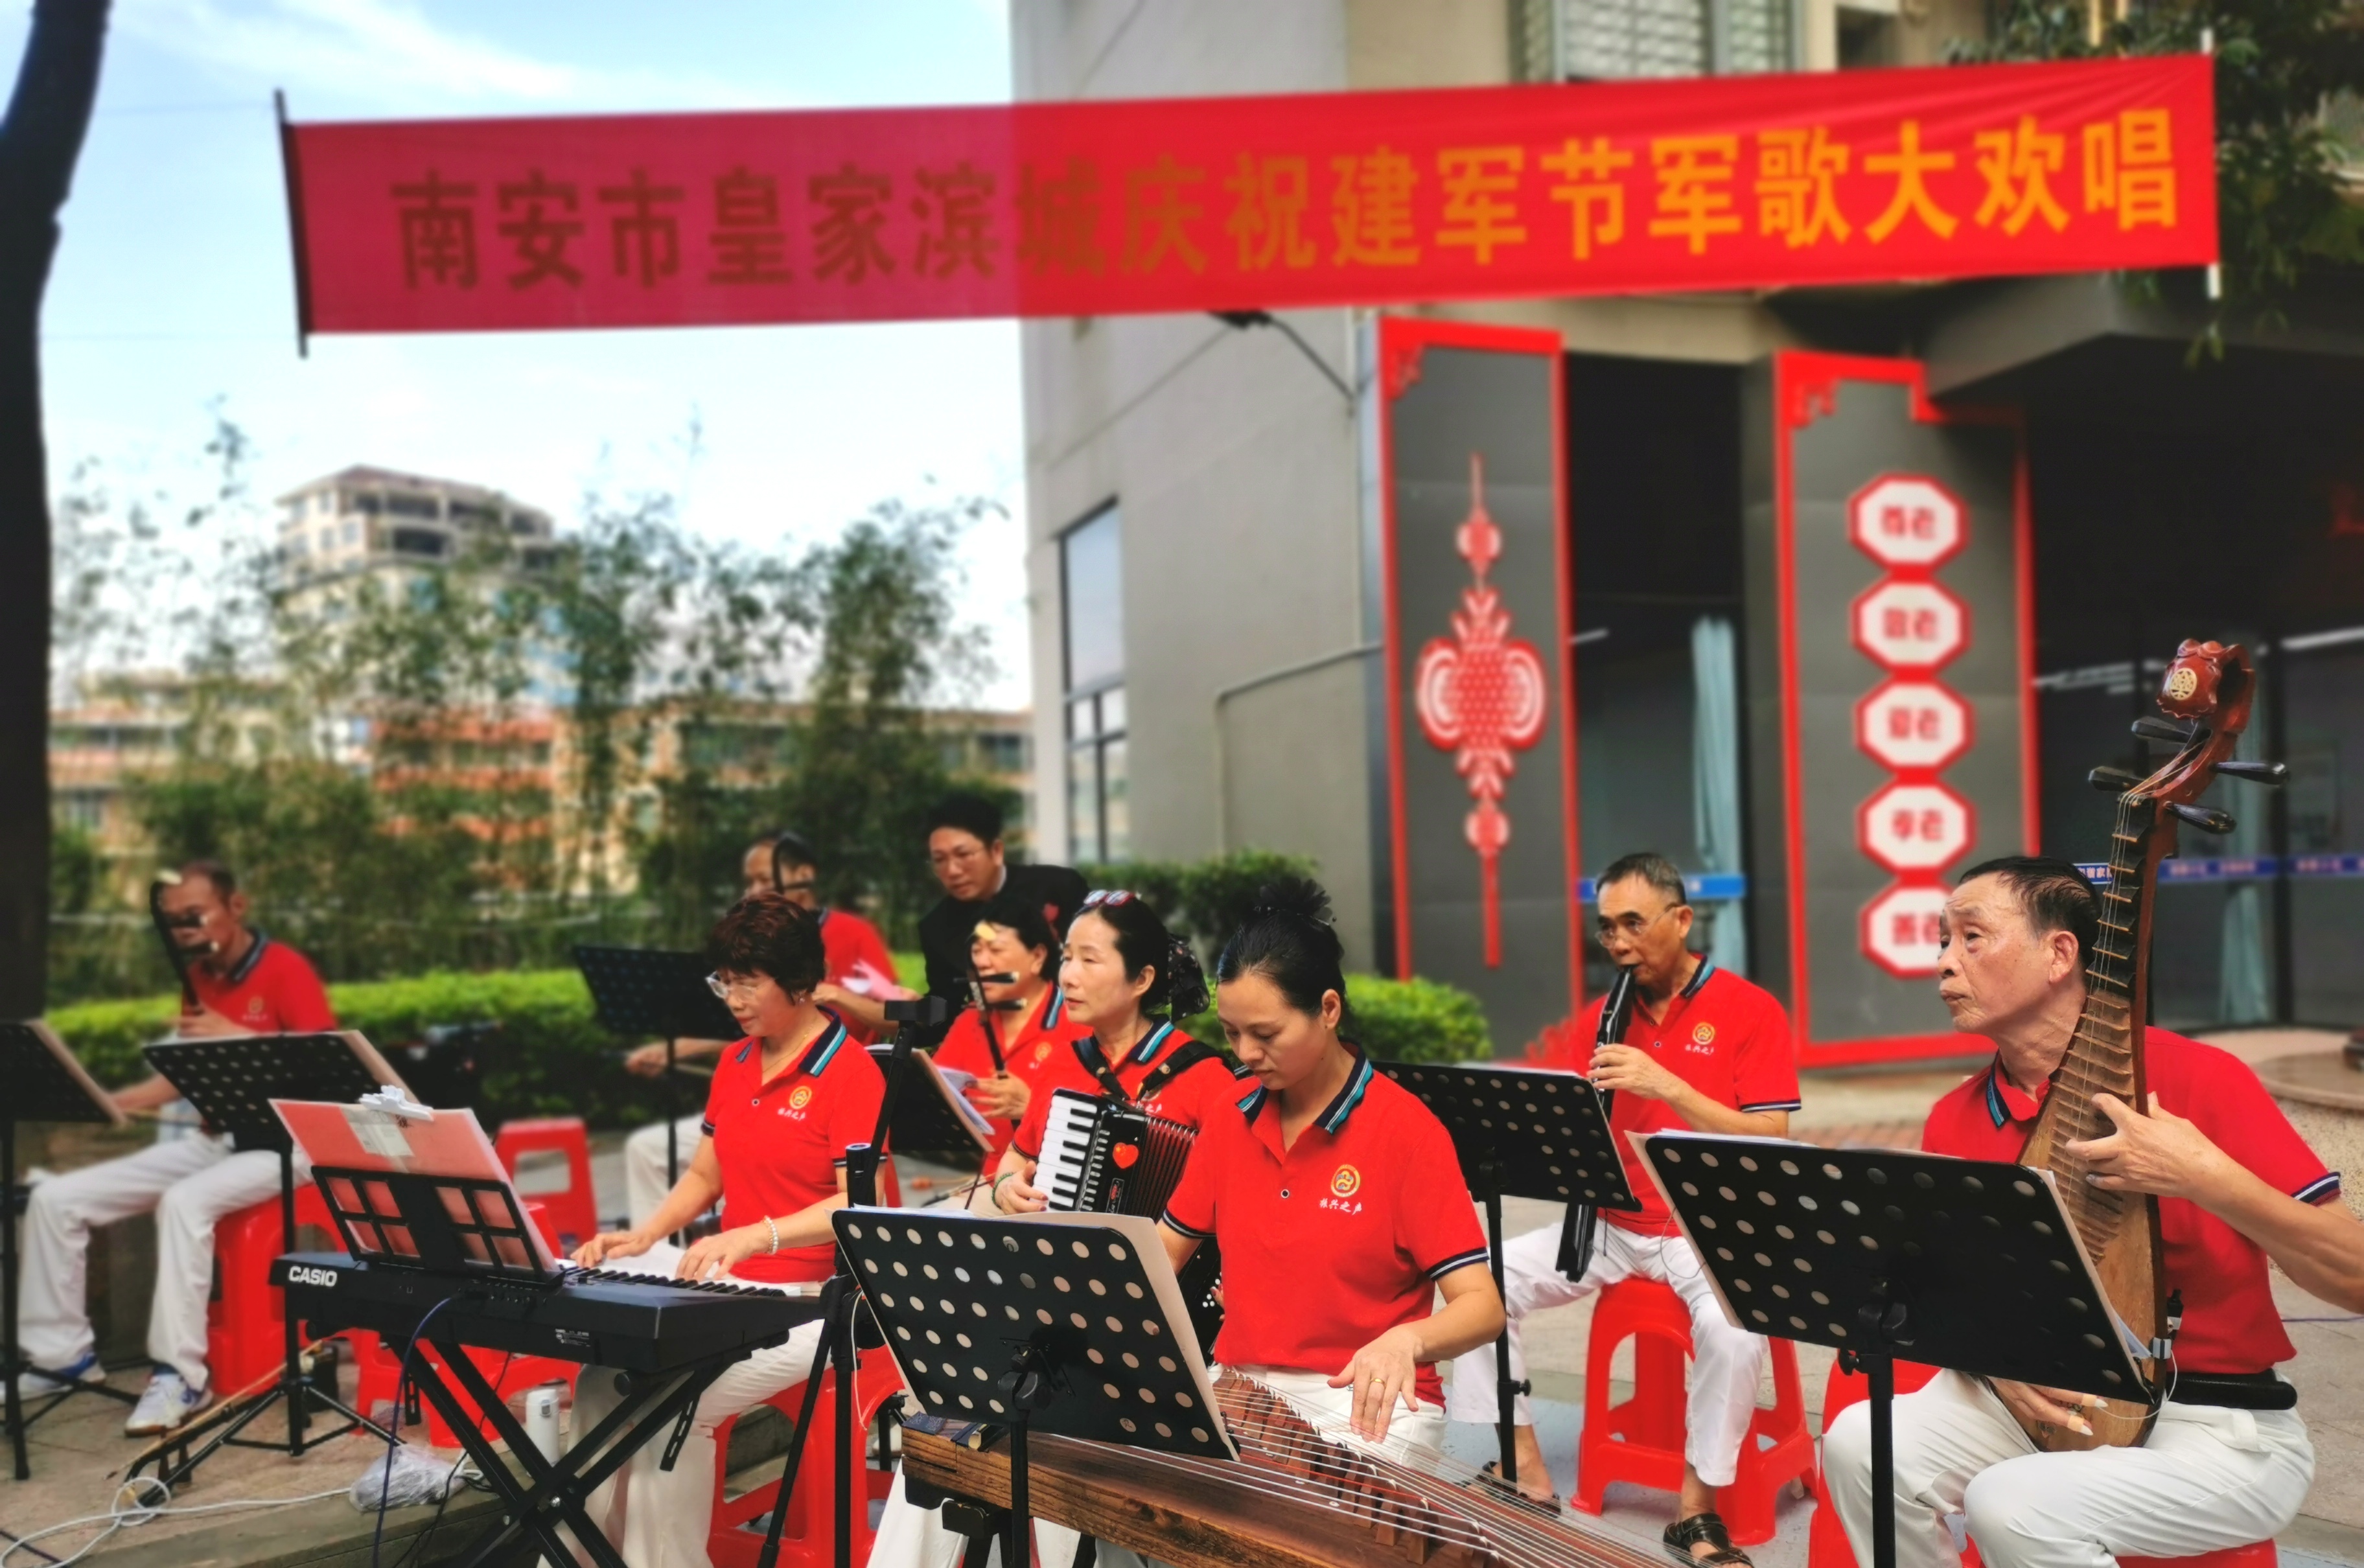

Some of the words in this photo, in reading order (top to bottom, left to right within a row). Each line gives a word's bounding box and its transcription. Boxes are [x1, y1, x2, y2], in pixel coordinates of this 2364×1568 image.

[389, 107, 2175, 290] 南安市皇家滨城庆祝建军节军歌大欢唱
[289, 1265, 338, 1287] CASIO
